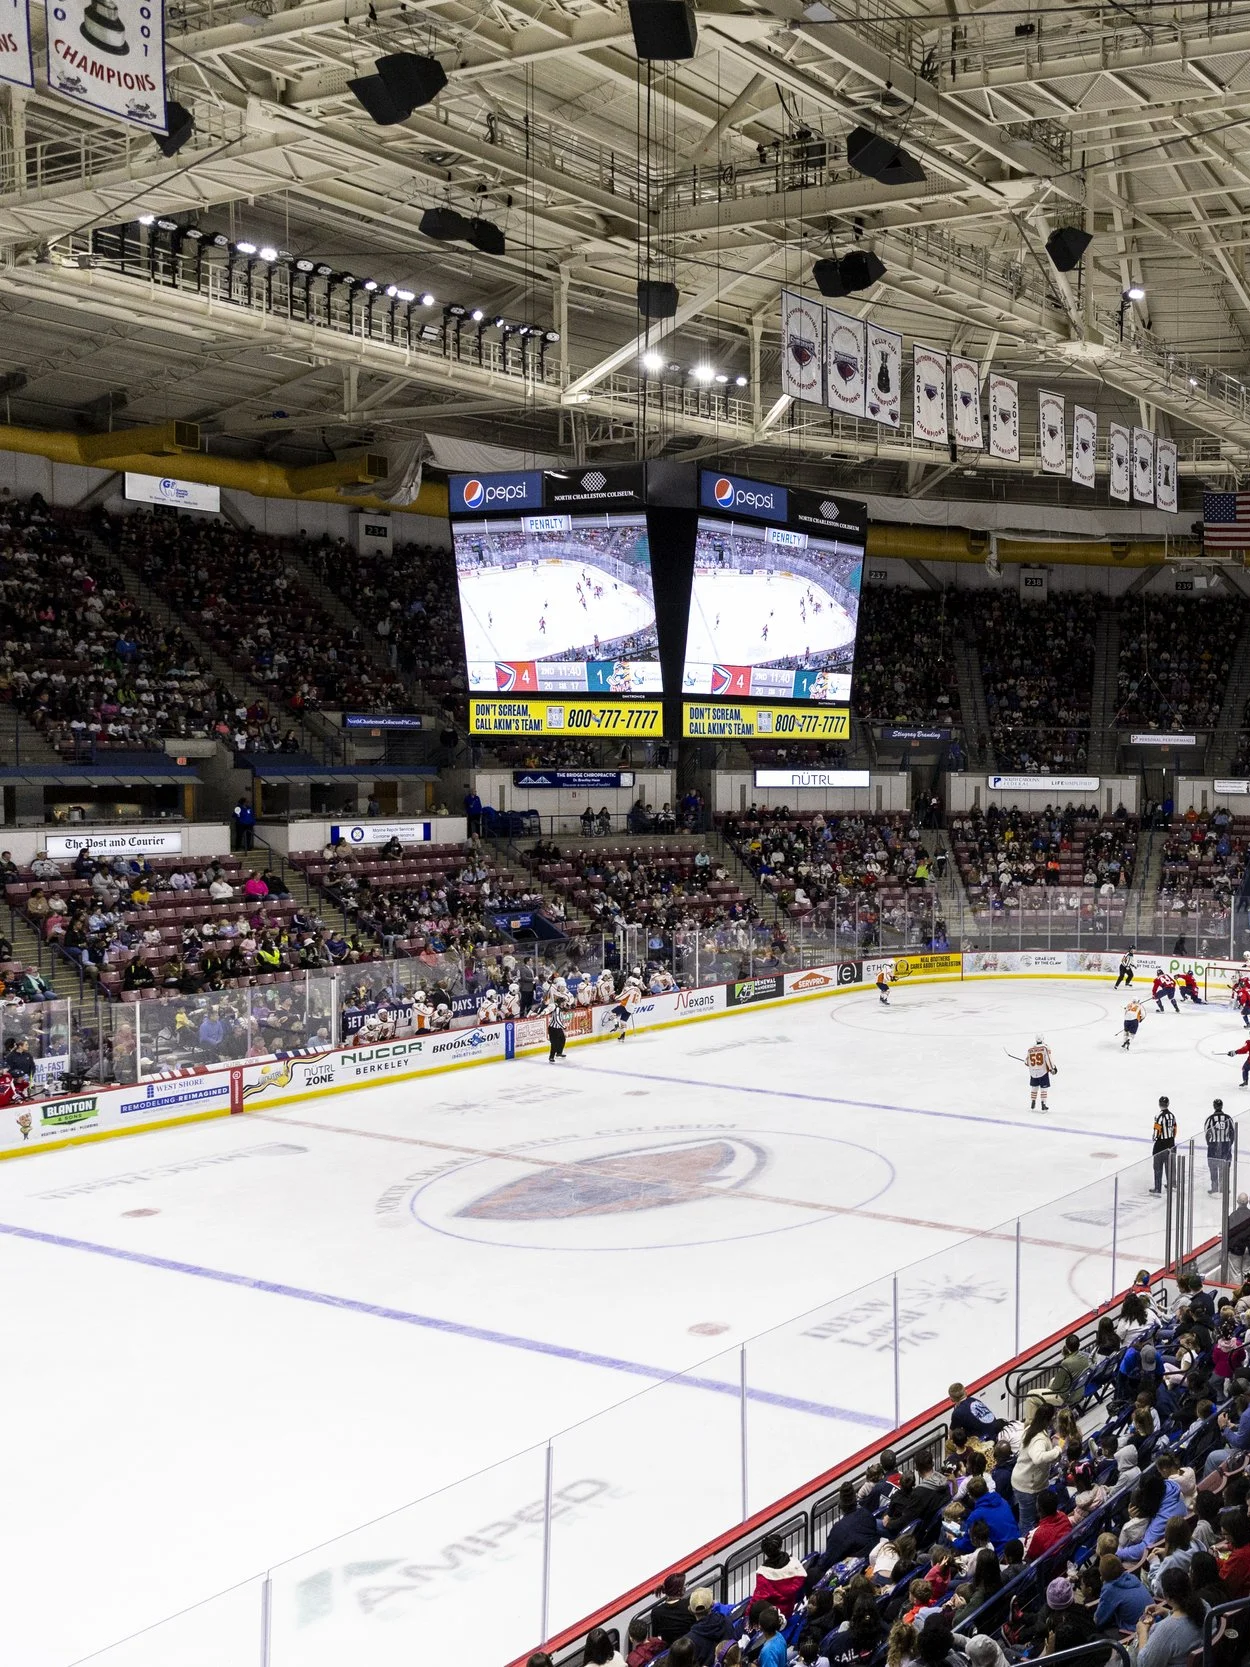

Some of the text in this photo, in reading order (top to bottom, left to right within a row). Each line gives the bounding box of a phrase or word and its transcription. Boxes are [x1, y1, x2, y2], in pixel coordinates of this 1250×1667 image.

[54, 39, 156, 92] CHAMPIONS
[888, 343, 898, 355] CUP
[786, 370, 818, 390] CHAMPIONS
[831, 385, 861, 403] CHAMPIONS
[871, 388, 898, 406] CHAMPIONS
[916, 421, 945, 437] CHAMPIONS
[955, 428, 980, 442] CHAMPIONS
[992, 440, 1017, 454] CHAMPIONS
[1042, 456, 1064, 468] CHAMPIONS
[486, 482, 526, 502] pepsi
[736, 490, 774, 509] pepsi
[367, 526, 386, 536] 234
[529, 518, 564, 530] PENALTY
[813, 518, 839, 527] CHARLESTON
[840, 522, 860, 531] COLISEUM
[772, 531, 800, 546] PENALTY
[522, 669, 530, 684] 4
[559, 665, 581, 676] 11:40
[596, 669, 603, 684] 1
[770, 672, 790, 683] 11:40
[544, 682, 553, 690] 20
[736, 674, 744, 688] 4
[802, 678, 808, 692] 1
[476, 704, 531, 718] DON'T SCREAM,
[690, 707, 743, 722] DON'T SCREAM,
[476, 718, 543, 731] CALL AKIM'S TEAM!
[690, 721, 754, 736] CALL AKIM'S TEAM!
[892, 730, 941, 740] Stingray Branding
[792, 772, 834, 785] NÜTRL
[65, 836, 165, 850] The Post and Courier
[1170, 959, 1227, 979] Publix
[452, 1001, 474, 1011] DAYS.
[674, 991, 715, 1011] Nexans
[341, 1042, 423, 1066] NUCOR
[1030, 1053, 1044, 1066] 59
[35, 1061, 65, 1073] RA-FAST
[356, 1059, 409, 1075] BERKELEY
[156, 1079, 204, 1092] WEST SHORE
[305, 1073, 334, 1086] ZONE
[122, 1097, 175, 1112] REMODELING
[178, 1088, 228, 1101] REIMAGINED
[47, 1100, 93, 1118] BLANTON
[375, 1185, 402, 1214] NORTH
[798, 1298, 891, 1339] IBEW
[838, 1309, 927, 1347] Local
